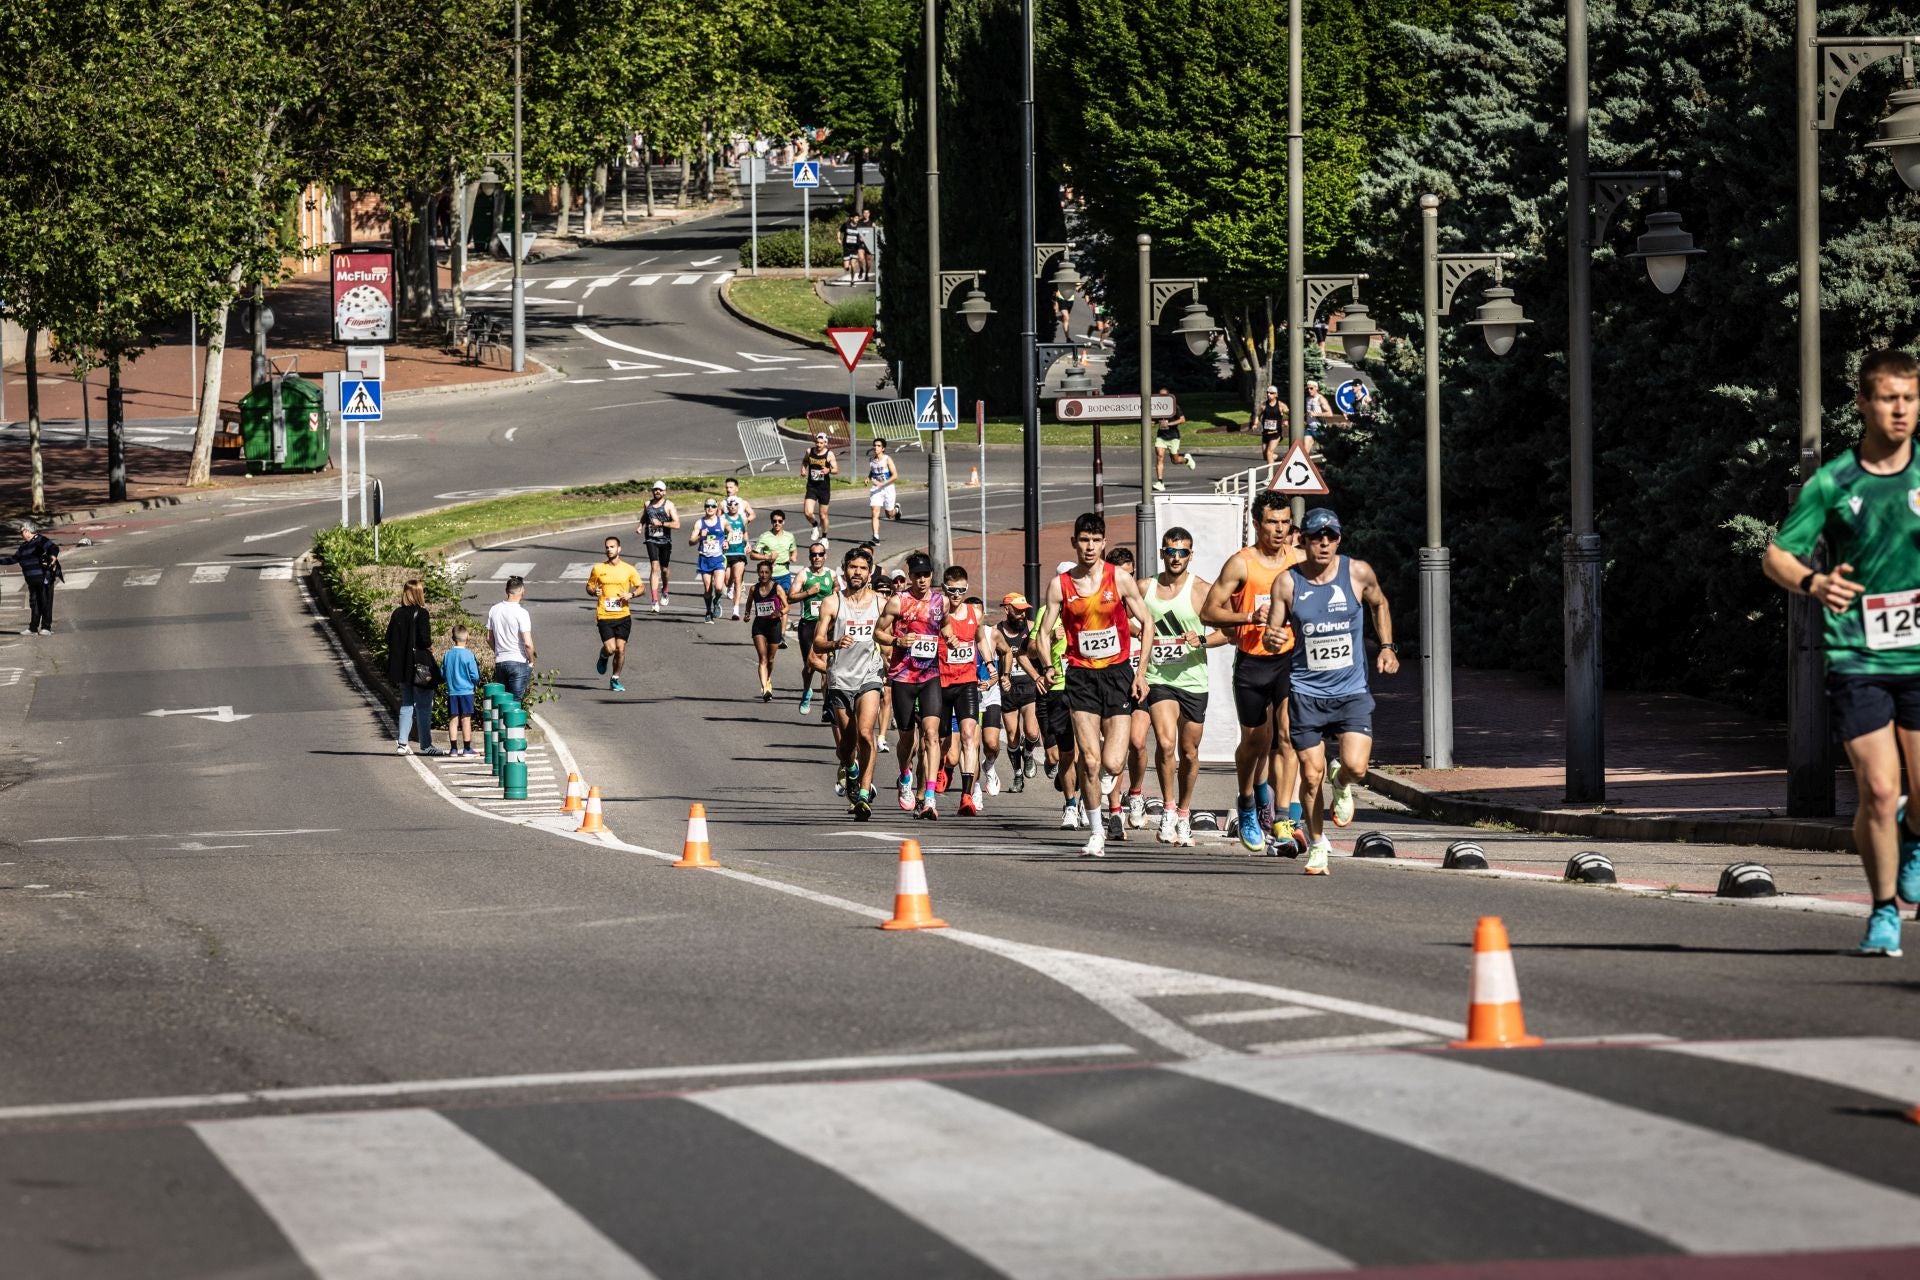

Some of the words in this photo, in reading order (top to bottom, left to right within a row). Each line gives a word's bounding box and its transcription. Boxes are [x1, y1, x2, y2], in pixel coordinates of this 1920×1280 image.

[336, 271, 388, 284] McFlurry
[849, 626, 872, 636] 512
[1316, 621, 1350, 633] Chiruca
[915, 641, 936, 653] 463
[1082, 635, 1117, 651] 1237
[951, 647, 973, 659] 403
[1154, 645, 1183, 658] 324
[1310, 644, 1351, 661] 1252
